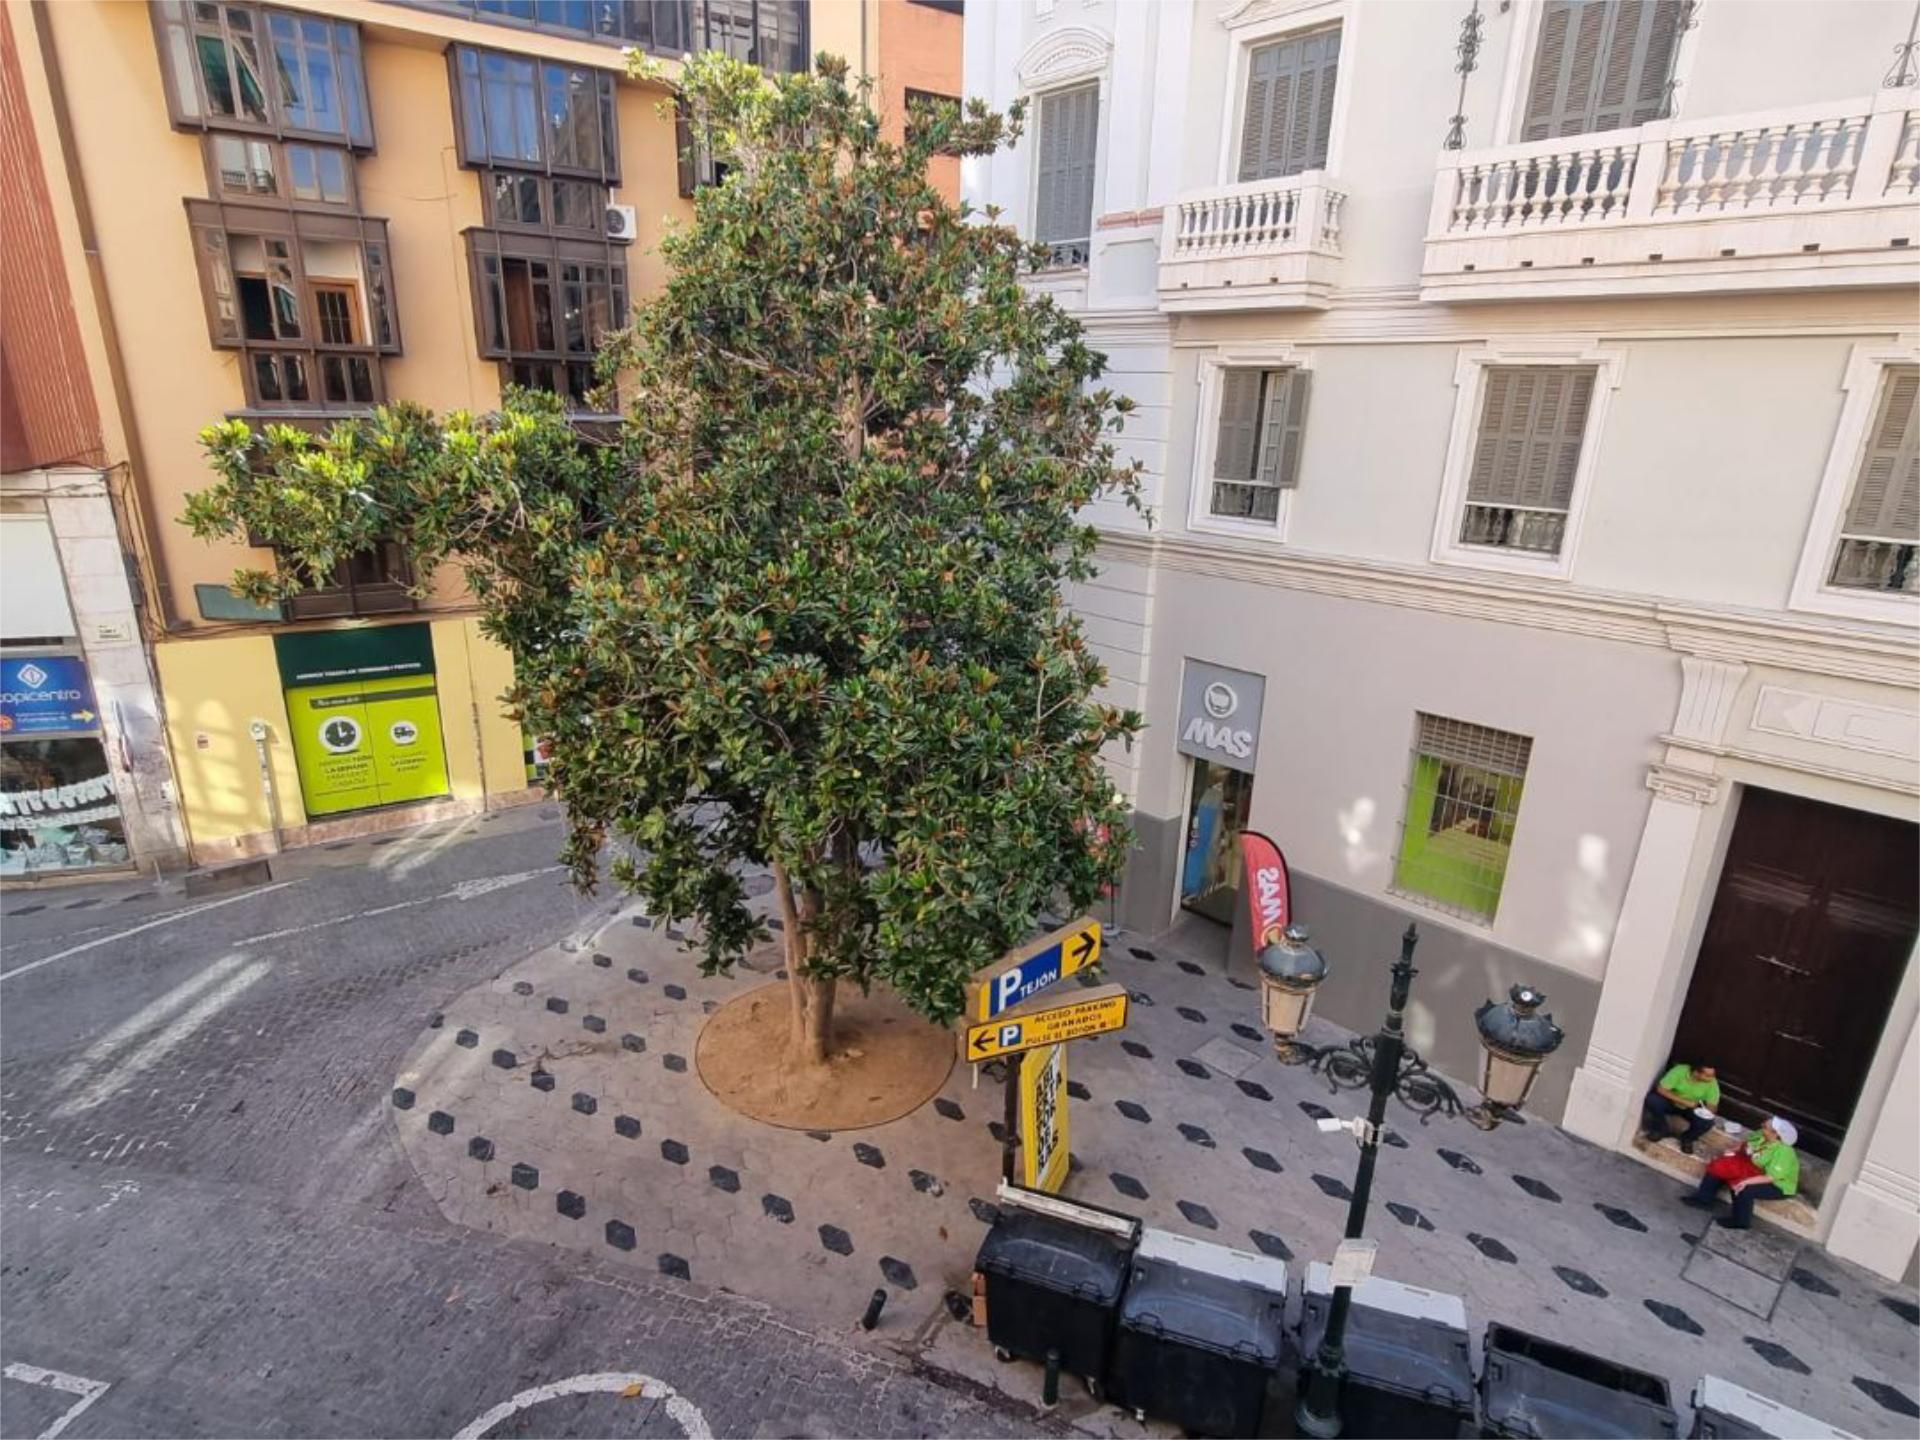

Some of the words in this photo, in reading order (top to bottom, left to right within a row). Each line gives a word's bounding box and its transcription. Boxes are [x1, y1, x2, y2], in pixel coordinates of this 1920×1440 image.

[0, 689, 80, 705] opicentro
[1183, 718, 1253, 759] MAS
[999, 968, 1022, 1012] P
[1035, 1009, 1071, 1023] ACCESO
[1075, 1001, 1116, 1014] PARKING
[1001, 1026, 1020, 1046] P
